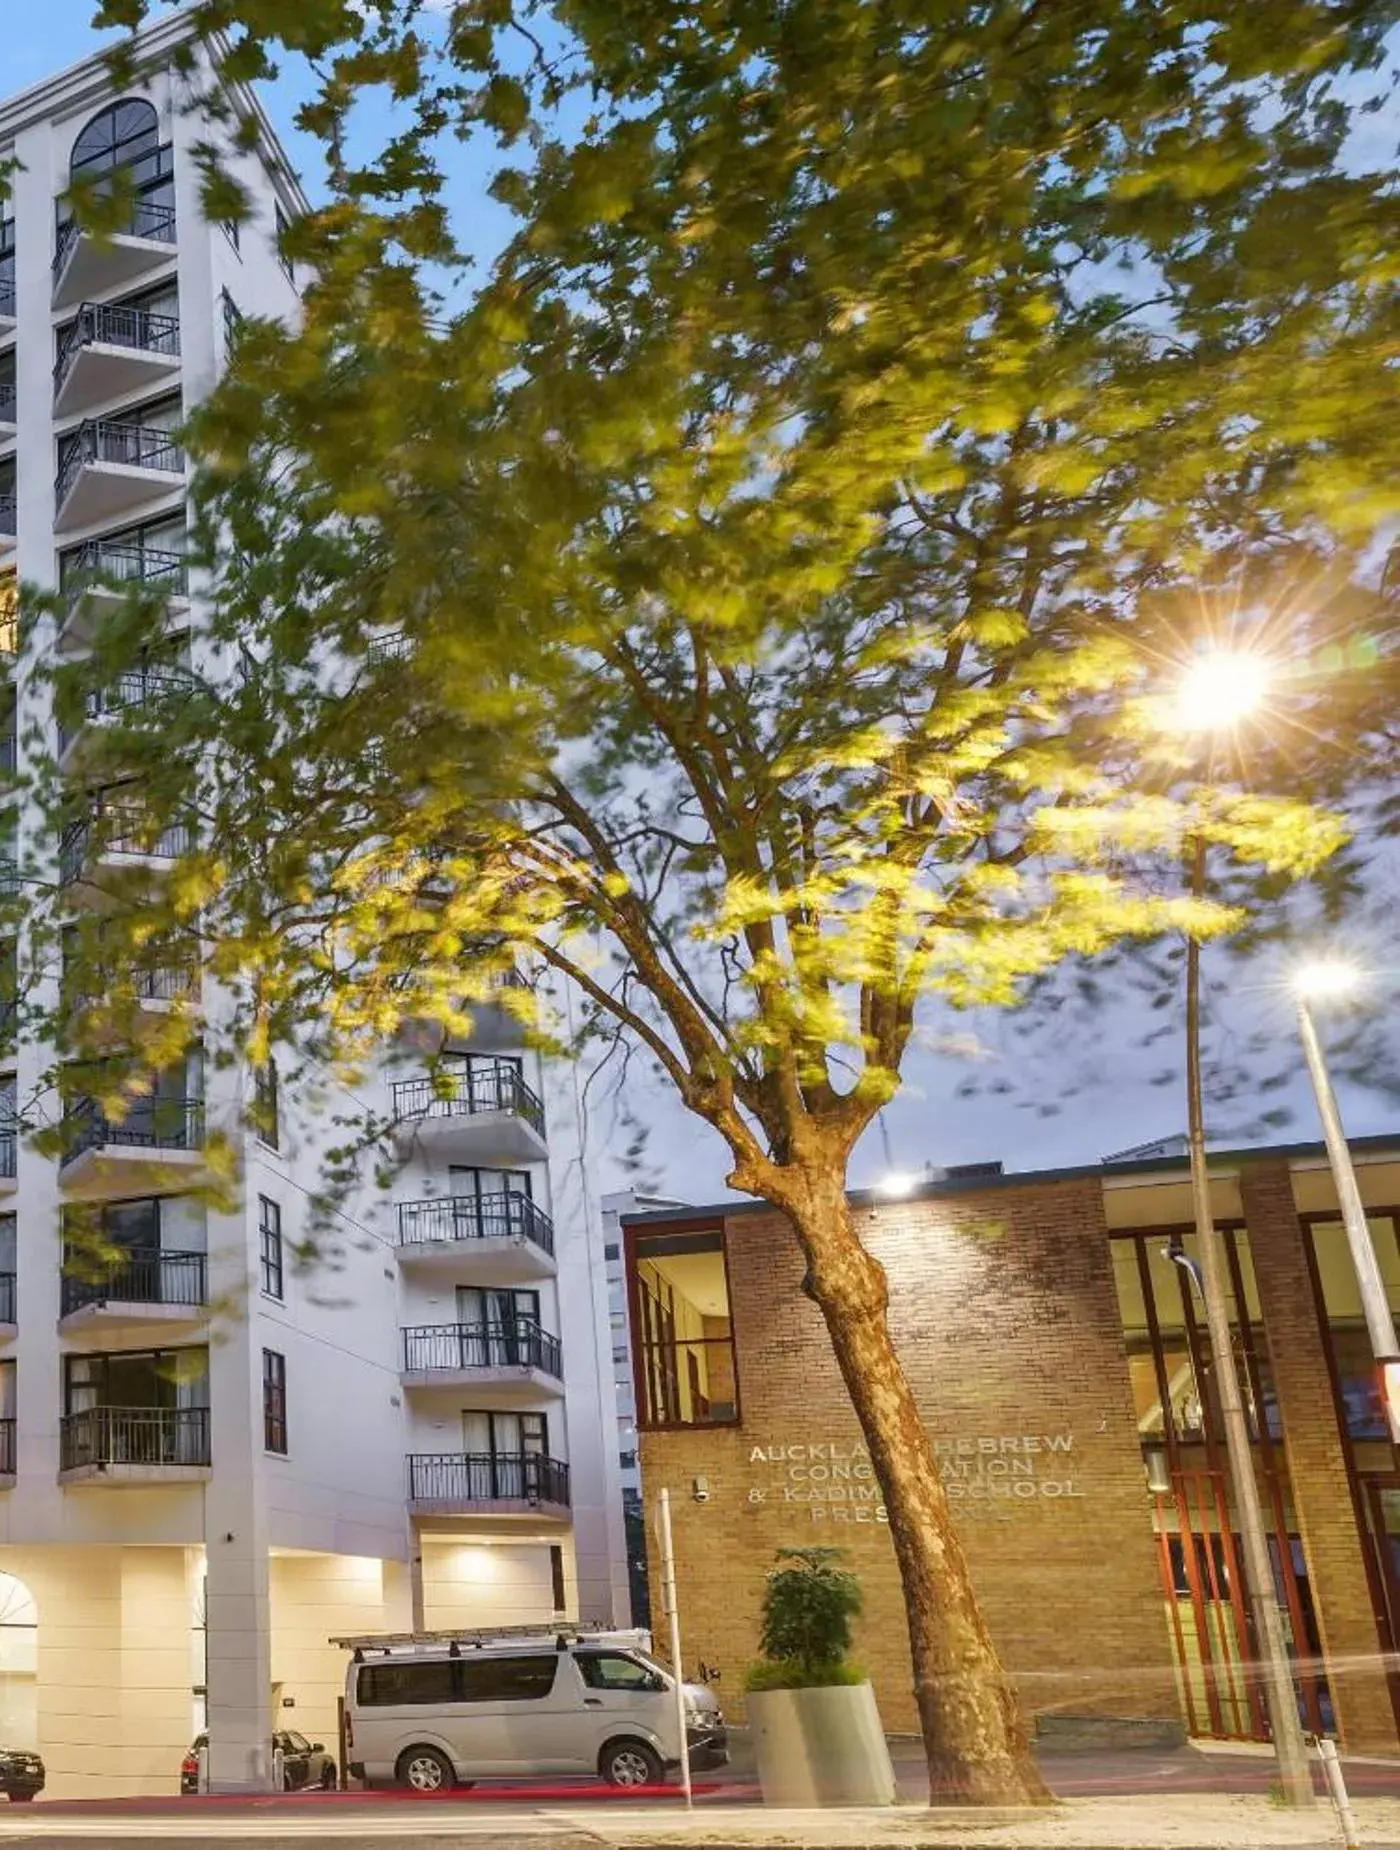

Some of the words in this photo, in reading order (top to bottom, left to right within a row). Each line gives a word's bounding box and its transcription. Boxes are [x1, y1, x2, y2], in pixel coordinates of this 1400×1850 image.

[750, 1441, 871, 1462] AUCKLA
[933, 1435, 1074, 1455] HEBREW
[789, 1459, 1034, 1481] CONGATION
[748, 1488, 768, 1504] &
[783, 1484, 879, 1502] KADIM
[947, 1480, 1086, 1498] SCHOOL
